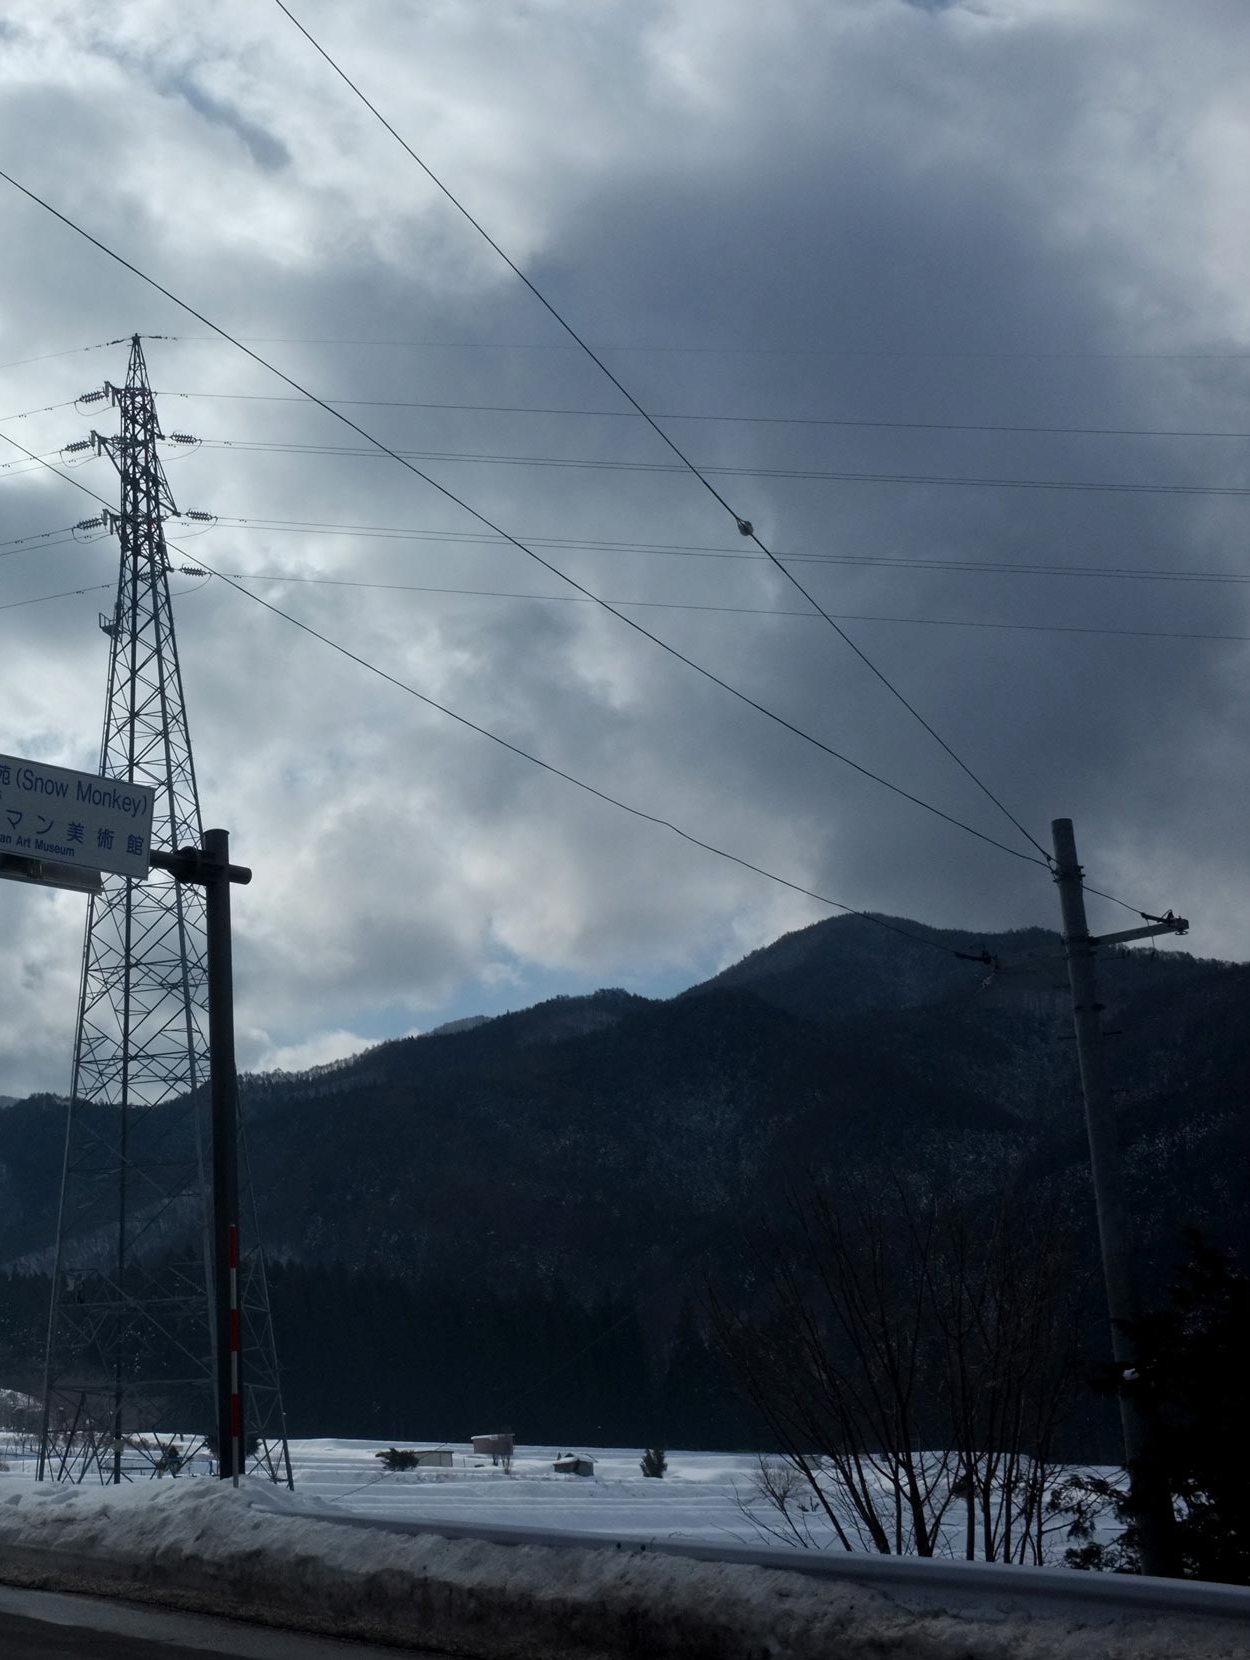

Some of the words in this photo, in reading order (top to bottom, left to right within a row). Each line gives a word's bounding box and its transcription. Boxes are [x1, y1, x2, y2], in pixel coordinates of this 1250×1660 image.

[76, 781, 148, 817] Monkey)
[16, 835, 31, 848] Art
[34, 839, 75, 856] Museum
